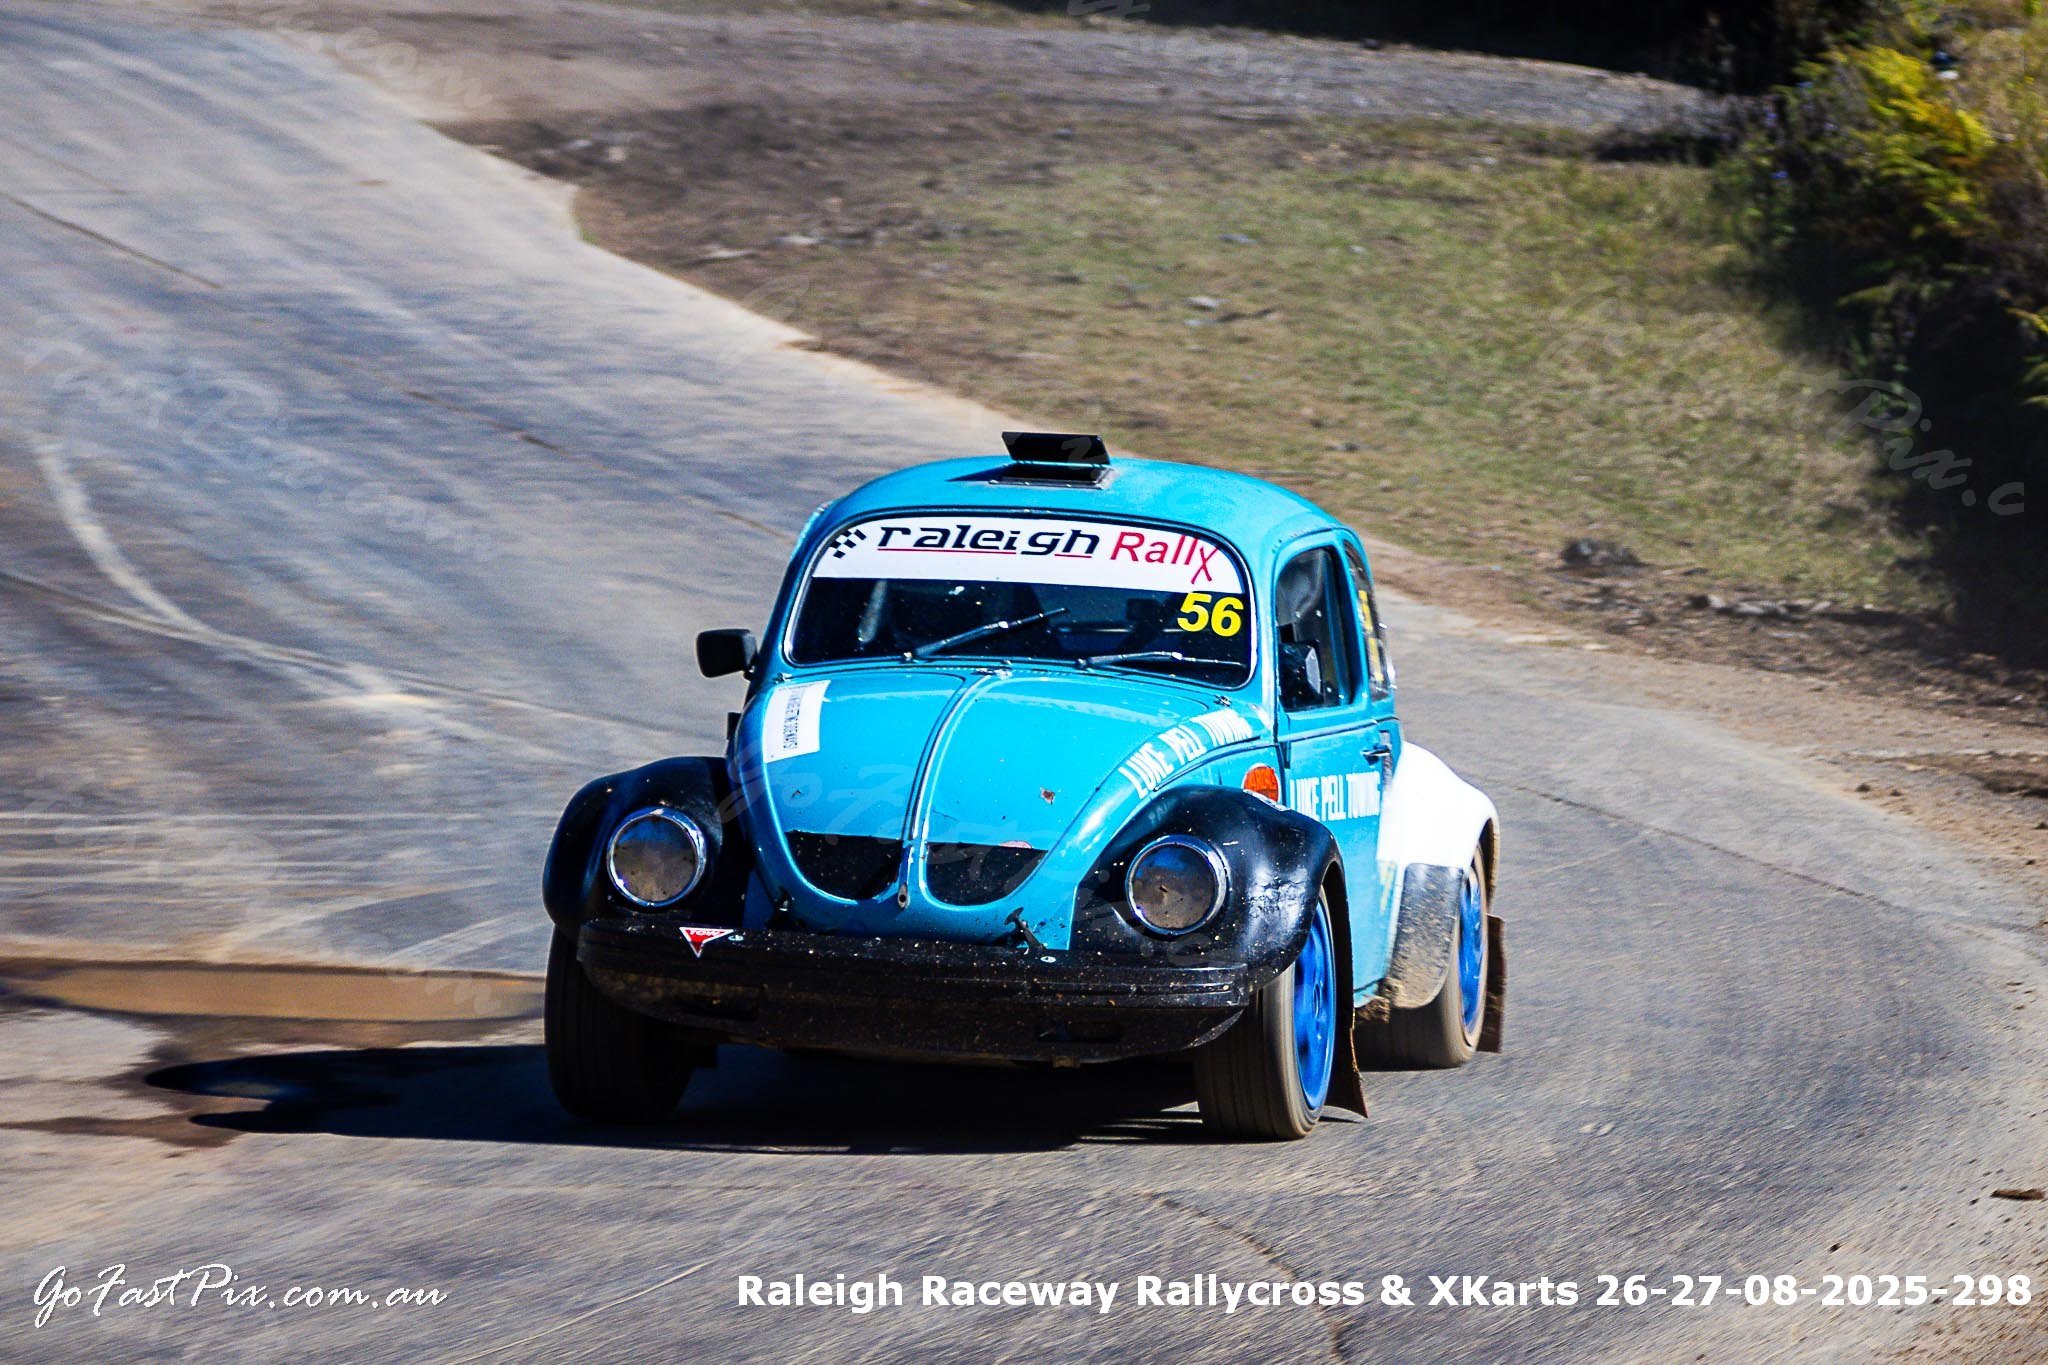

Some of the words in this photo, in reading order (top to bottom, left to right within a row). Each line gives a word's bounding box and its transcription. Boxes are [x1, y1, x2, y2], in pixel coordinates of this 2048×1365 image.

[877, 524, 1100, 556] raleigh
[1177, 592, 1244, 637] 56
[1118, 742, 1174, 800] LUKE
[1158, 724, 1207, 766] PELL
[1321, 774, 1346, 822] PELL
